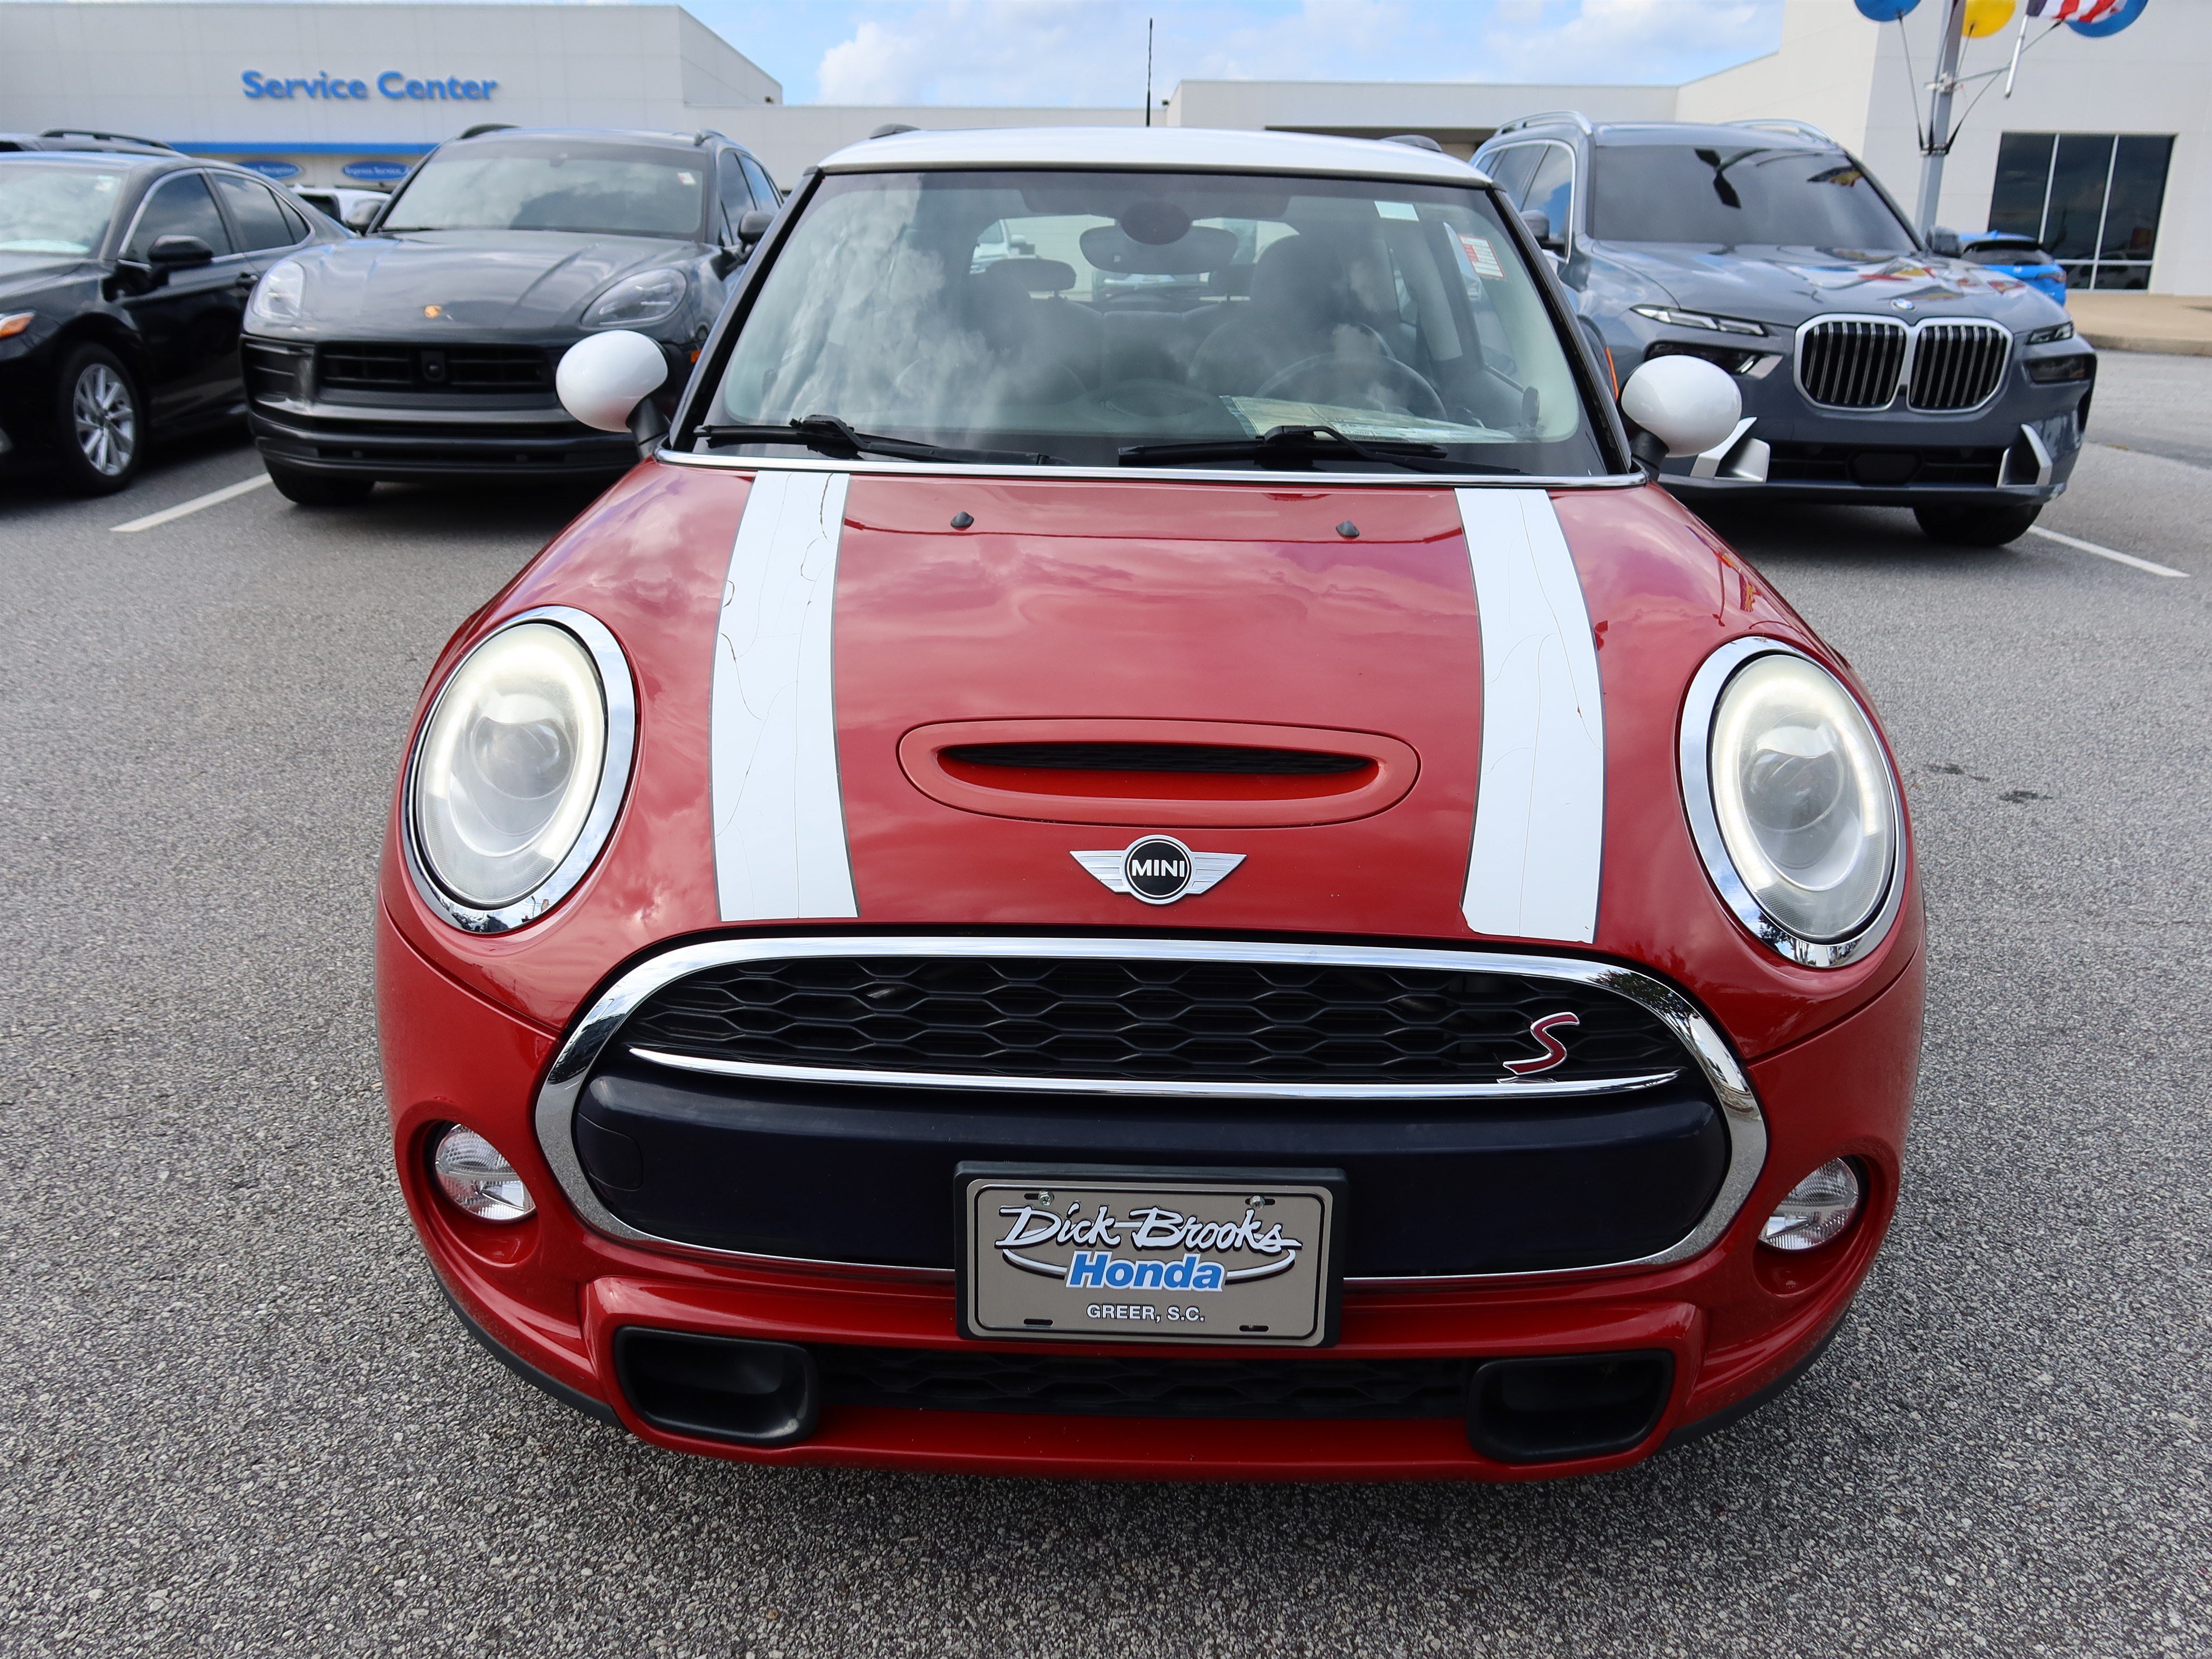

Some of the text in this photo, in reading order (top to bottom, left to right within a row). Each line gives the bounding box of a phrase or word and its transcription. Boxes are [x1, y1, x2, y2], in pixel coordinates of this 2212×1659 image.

[241, 70, 498, 100] Service Center
[1132, 859, 1185, 877] MINI
[1502, 1011, 1580, 1075] S
[995, 1202, 1303, 1253] Dick Brooks
[1065, 1250, 1224, 1292] Honda
[1086, 1304, 1205, 1323] GREER, S.C.
